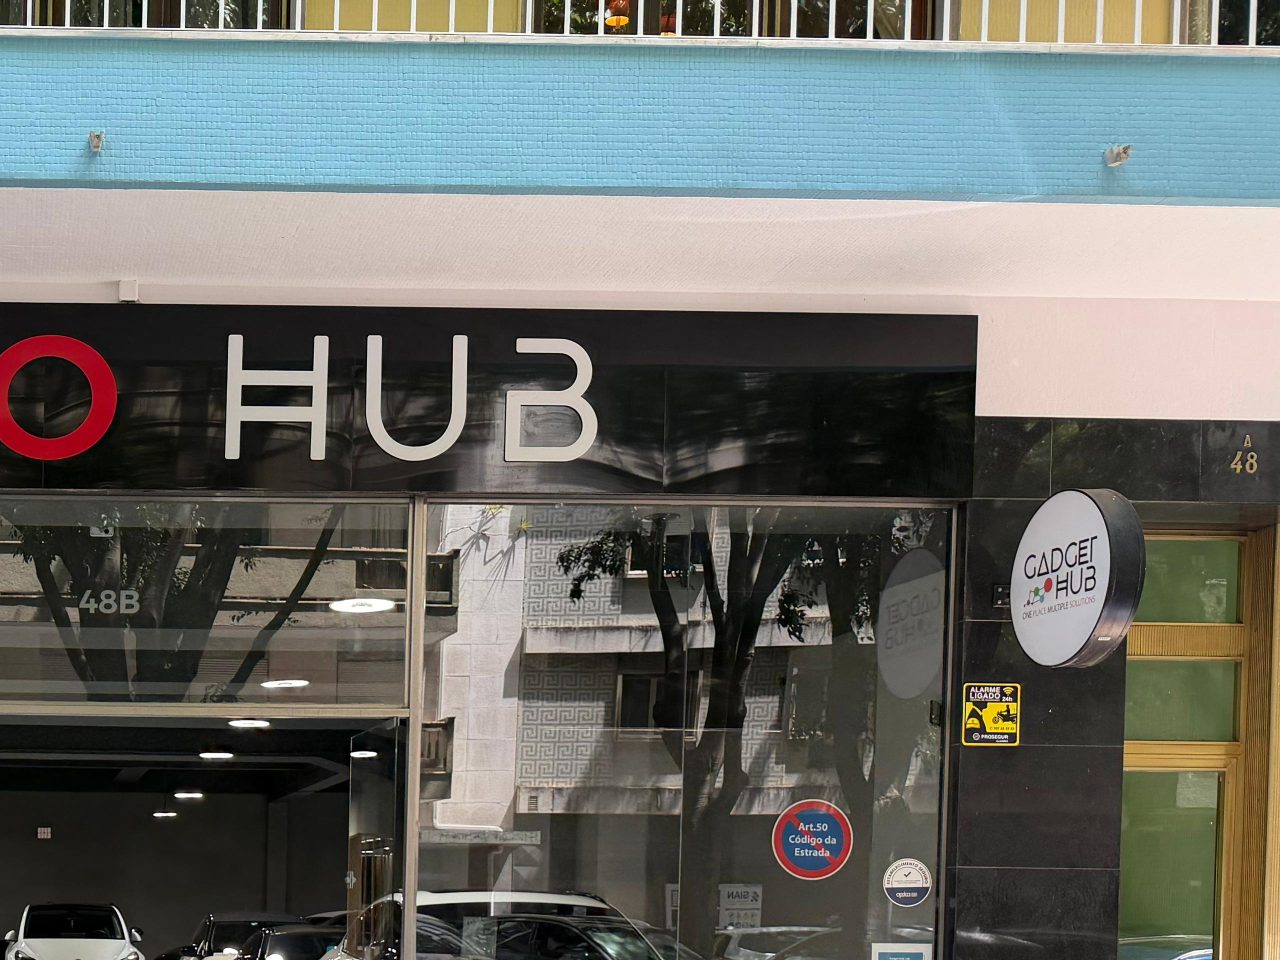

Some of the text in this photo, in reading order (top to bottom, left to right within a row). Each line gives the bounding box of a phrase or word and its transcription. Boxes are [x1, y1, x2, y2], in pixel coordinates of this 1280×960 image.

[224, 333, 598, 462] HUB
[1243, 434, 1252, 448] A
[1230, 450, 1258, 474] 48
[1023, 535, 1098, 580] GADGET
[1055, 565, 1097, 599] HUB
[78, 589, 140, 614] 48B
[1022, 595, 1096, 620] ONE PLACE MULTIPLE SOLUTIONS
[798, 822, 828, 832] Art.50
[788, 834, 837, 846] Código da
[794, 847, 830, 857] Estrada
